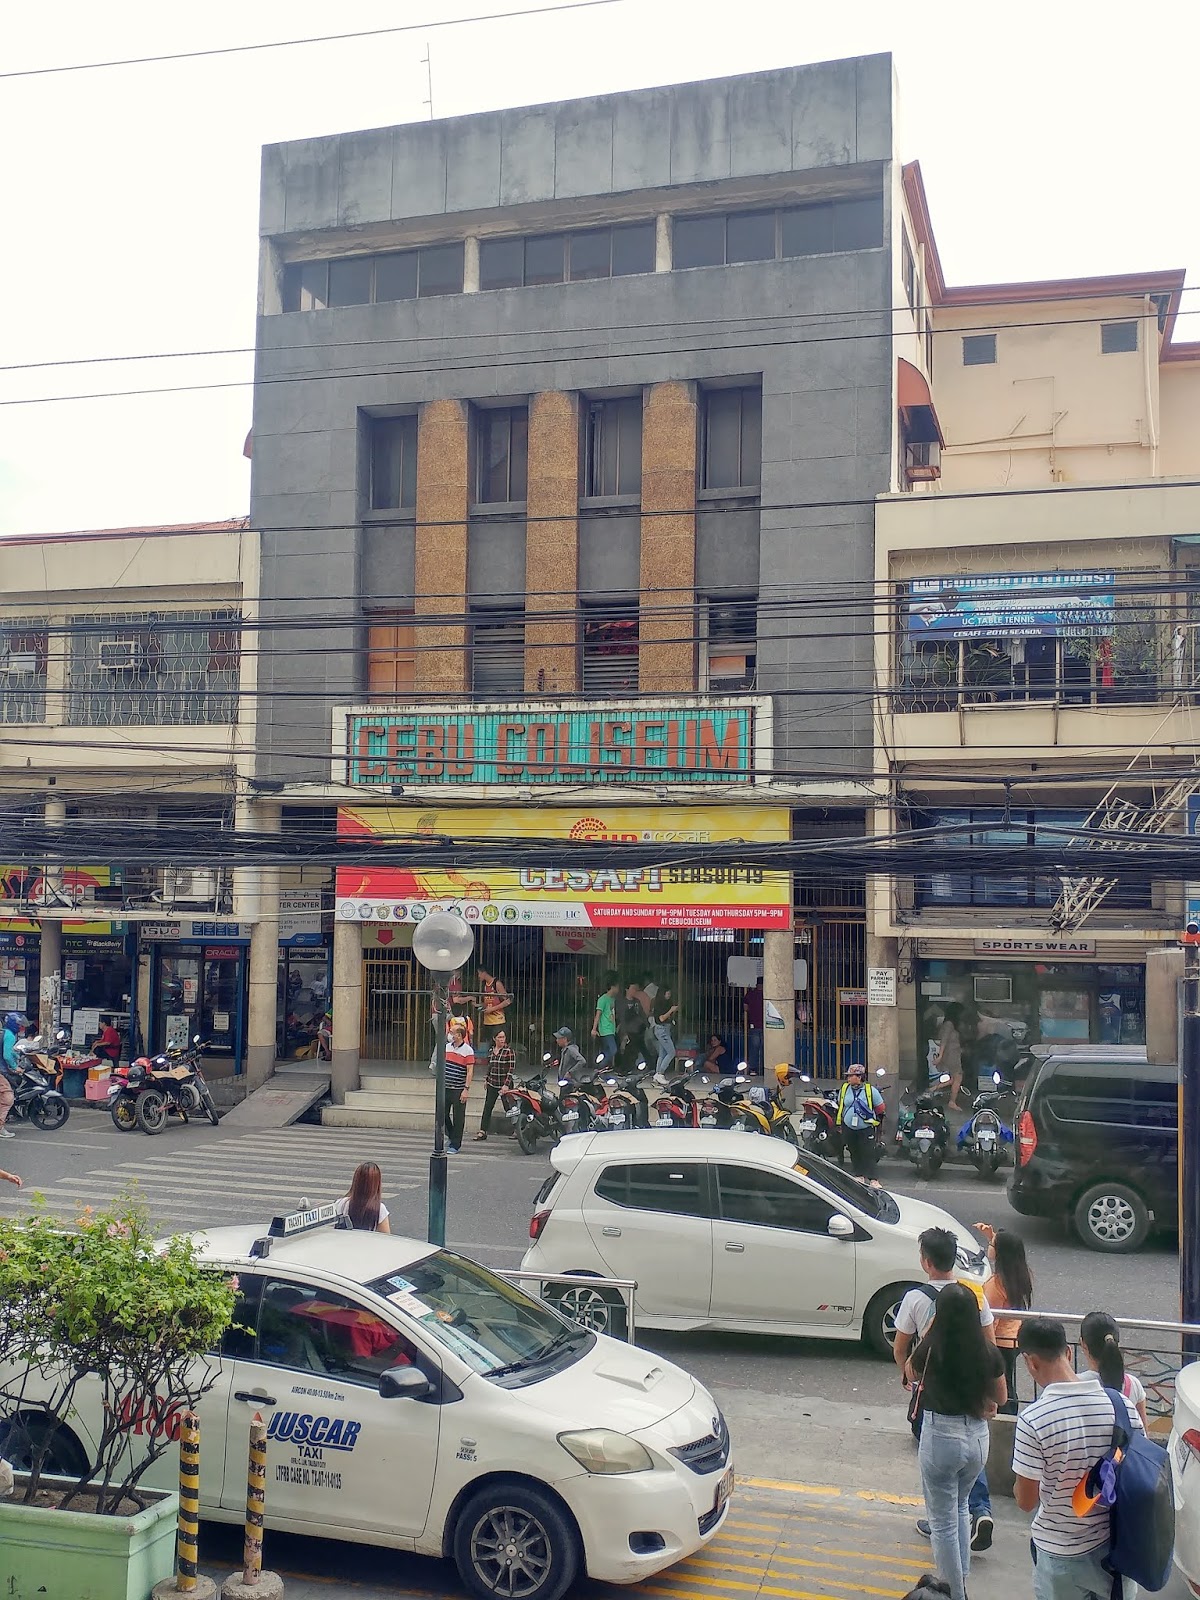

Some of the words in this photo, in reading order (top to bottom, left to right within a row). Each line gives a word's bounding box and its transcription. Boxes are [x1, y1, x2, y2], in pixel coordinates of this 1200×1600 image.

[962, 617, 975, 625] UC
[1005, 616, 1035, 624] TENNIS
[358, 724, 475, 776] CEBU
[496, 718, 740, 775] COLISEUM
[593, 908, 622, 917] SATURDAY
[685, 909, 711, 918] TUESDAY
[723, 909, 753, 918] THURSDAY
[660, 917, 668, 925] AT
[555, 930, 597, 938] RINGSIDE
[982, 941, 1088, 950] SPORTSWEAR
[305, 1210, 318, 1222] TAXI
[291, 1386, 307, 1395] AIRCON
[266, 1411, 362, 1449] JUSCAR
[297, 1445, 323, 1460] TAXI
[275, 1465, 290, 1482] LTFRB
[290, 1466, 302, 1484] CASE
